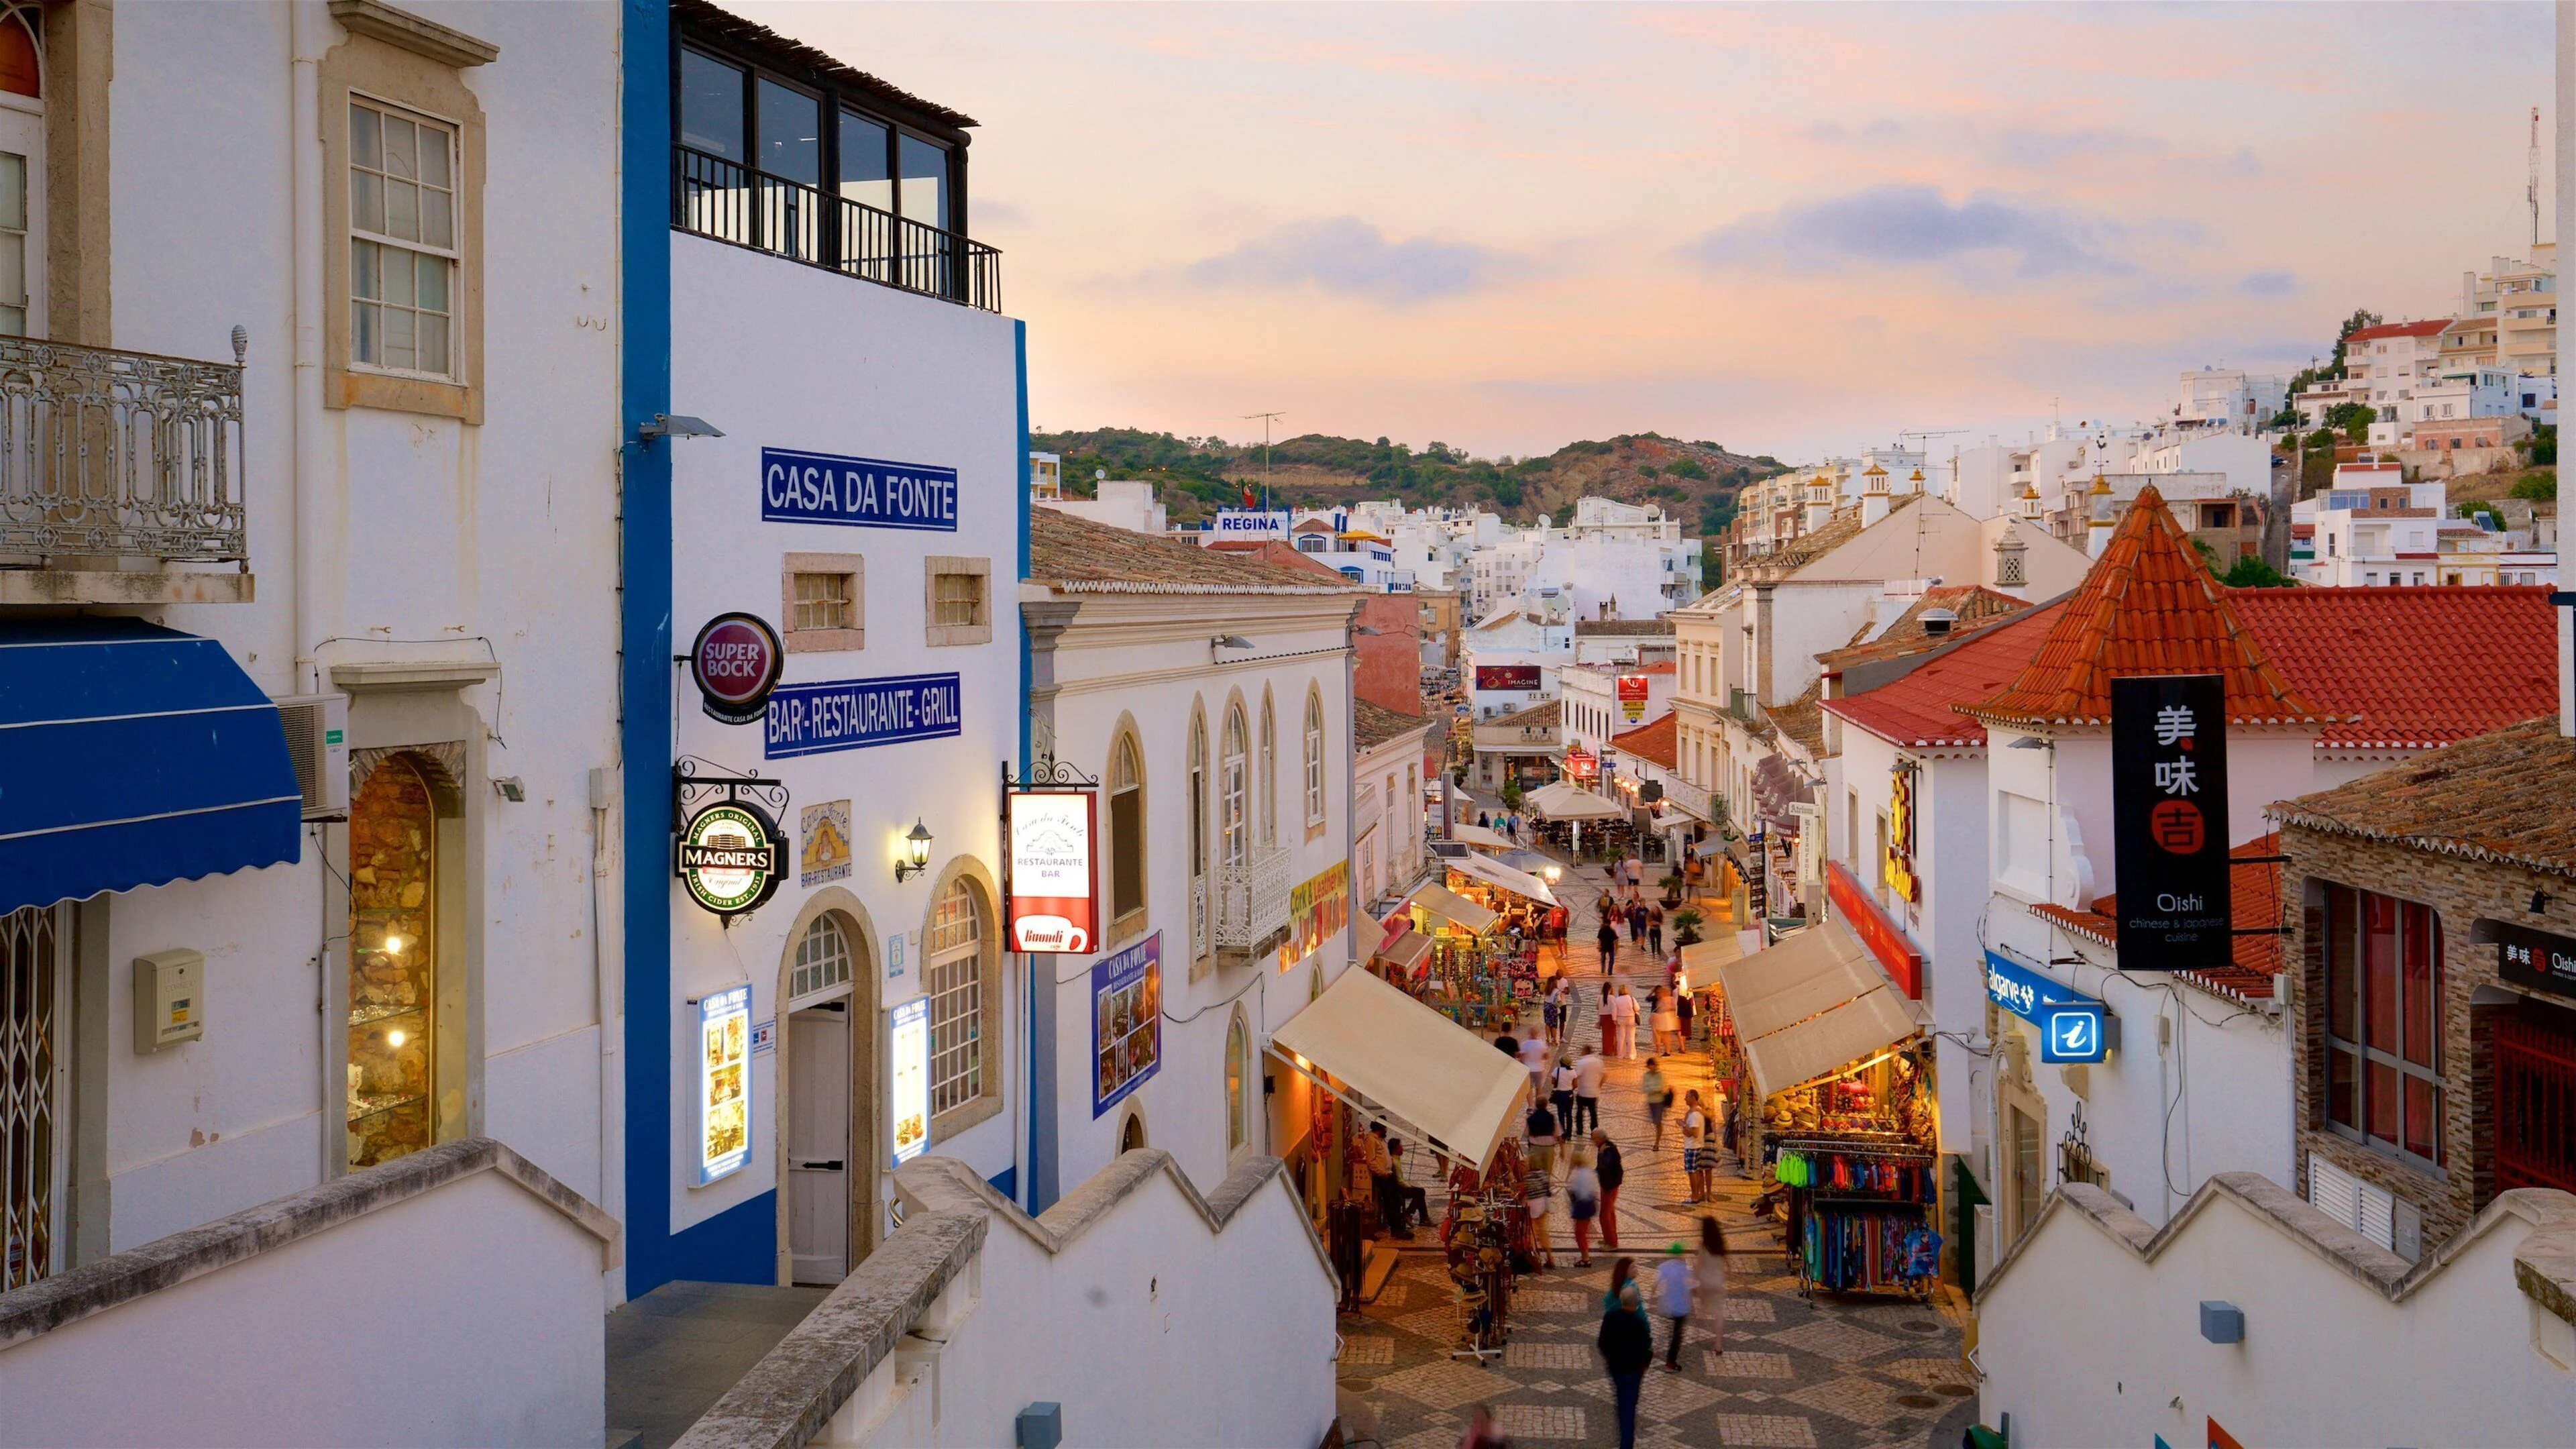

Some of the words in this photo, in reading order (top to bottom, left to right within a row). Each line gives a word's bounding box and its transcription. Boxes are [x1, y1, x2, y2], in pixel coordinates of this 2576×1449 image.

[767, 463, 838, 512] CASA
[845, 471, 879, 515] DA
[885, 475, 955, 520] FONTE
[1223, 518, 1279, 531] REGINA
[705, 643, 759, 660] SUPER
[707, 660, 757, 678] BOCK
[694, 812, 725, 841] MAGNERS
[728, 812, 761, 843] ORIGINAL
[685, 849, 768, 867] MAGNERS
[1018, 858, 1083, 867] RESTAURANTE
[1041, 870, 1060, 878] BAR
[692, 874, 707, 897] IRISH
[708, 895, 733, 906] CIDER
[2157, 893, 2203, 912] Oishi
[2129, 918, 2170, 928] chinese
[2174, 919, 2180, 928] &
[2184, 917, 2224, 930] japanese
[2165, 932, 2198, 942] cuisine
[2552, 953, 2576, 973] Oishi
[1988, 963, 2020, 1004] algarve
